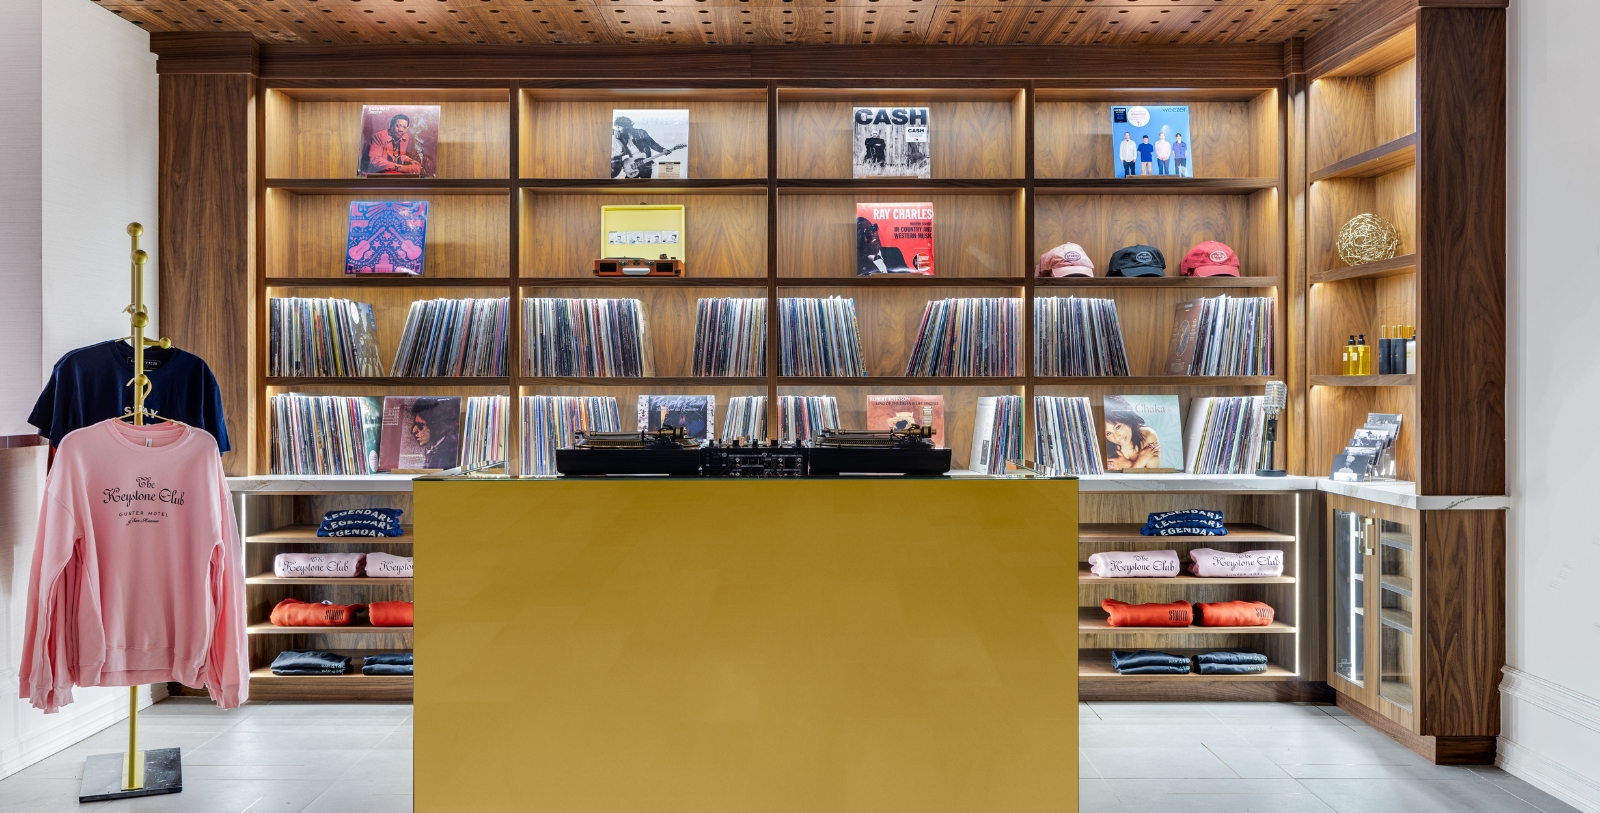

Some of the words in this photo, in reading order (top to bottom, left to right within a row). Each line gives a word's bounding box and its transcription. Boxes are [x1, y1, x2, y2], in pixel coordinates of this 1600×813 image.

[855, 109, 927, 125] CASH
[873, 209, 890, 220] RAY
[893, 209, 933, 220] CHARLES
[124, 406, 158, 419] SAY
[1135, 404, 1165, 413] Chaka
[136, 477, 155, 488] The
[103, 487, 156, 507] Keystone
[159, 488, 185, 505] Club
[1154, 509, 1222, 521] LEGENDARY
[282, 561, 324, 575] Keystone
[327, 561, 349, 571] Club
[1110, 560, 1150, 575] Keystone
[1153, 560, 1175, 571] Club
[1212, 556, 1255, 571] Keystone
[1257, 556, 1280, 566] Club
